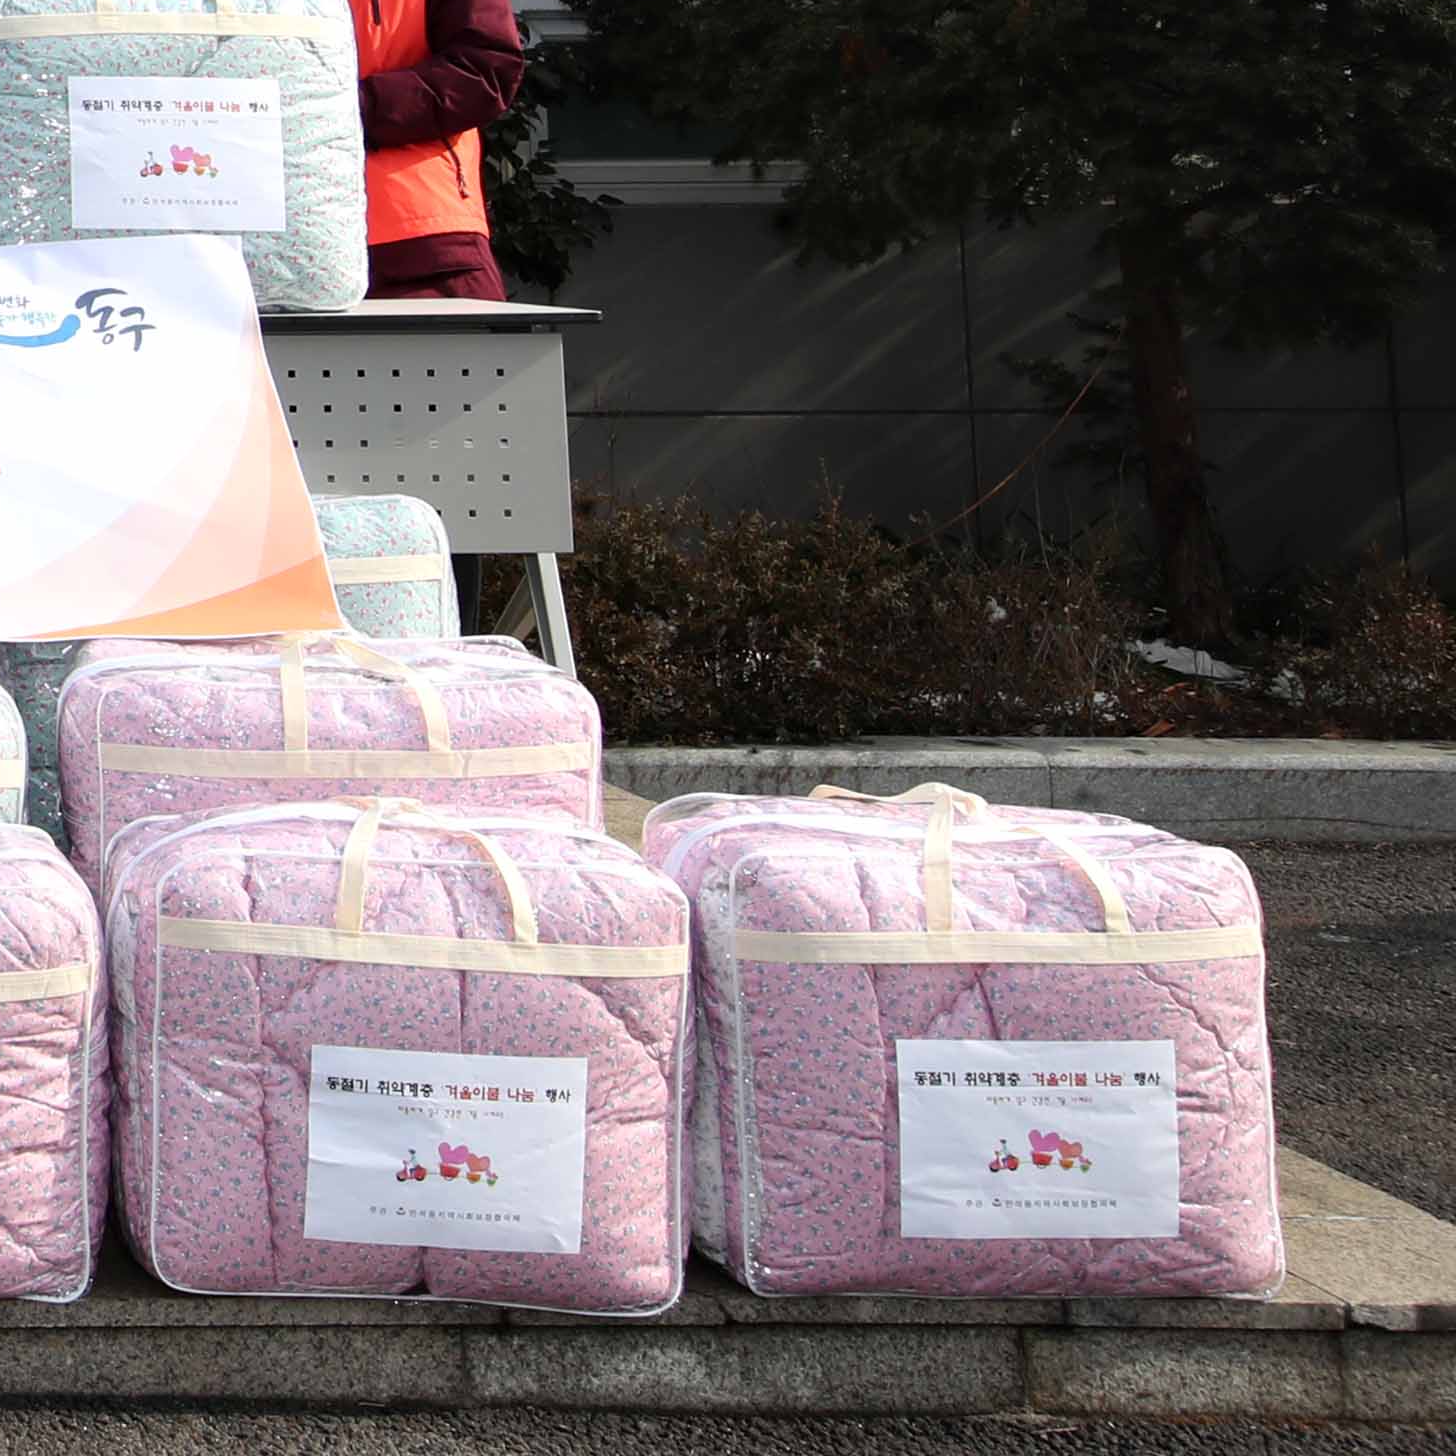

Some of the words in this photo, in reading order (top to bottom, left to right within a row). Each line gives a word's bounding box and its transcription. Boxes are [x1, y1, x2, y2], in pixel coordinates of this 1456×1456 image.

[75, 288, 156, 352] 동구
[326, 1076, 368, 1093] 동절기
[377, 1081, 433, 1097] 취약계층
[546, 1089, 571, 1104] 행사
[915, 1071, 956, 1086] 동절기
[964, 1072, 1021, 1086] 취약계층
[1134, 1072, 1160, 1087] 행사
